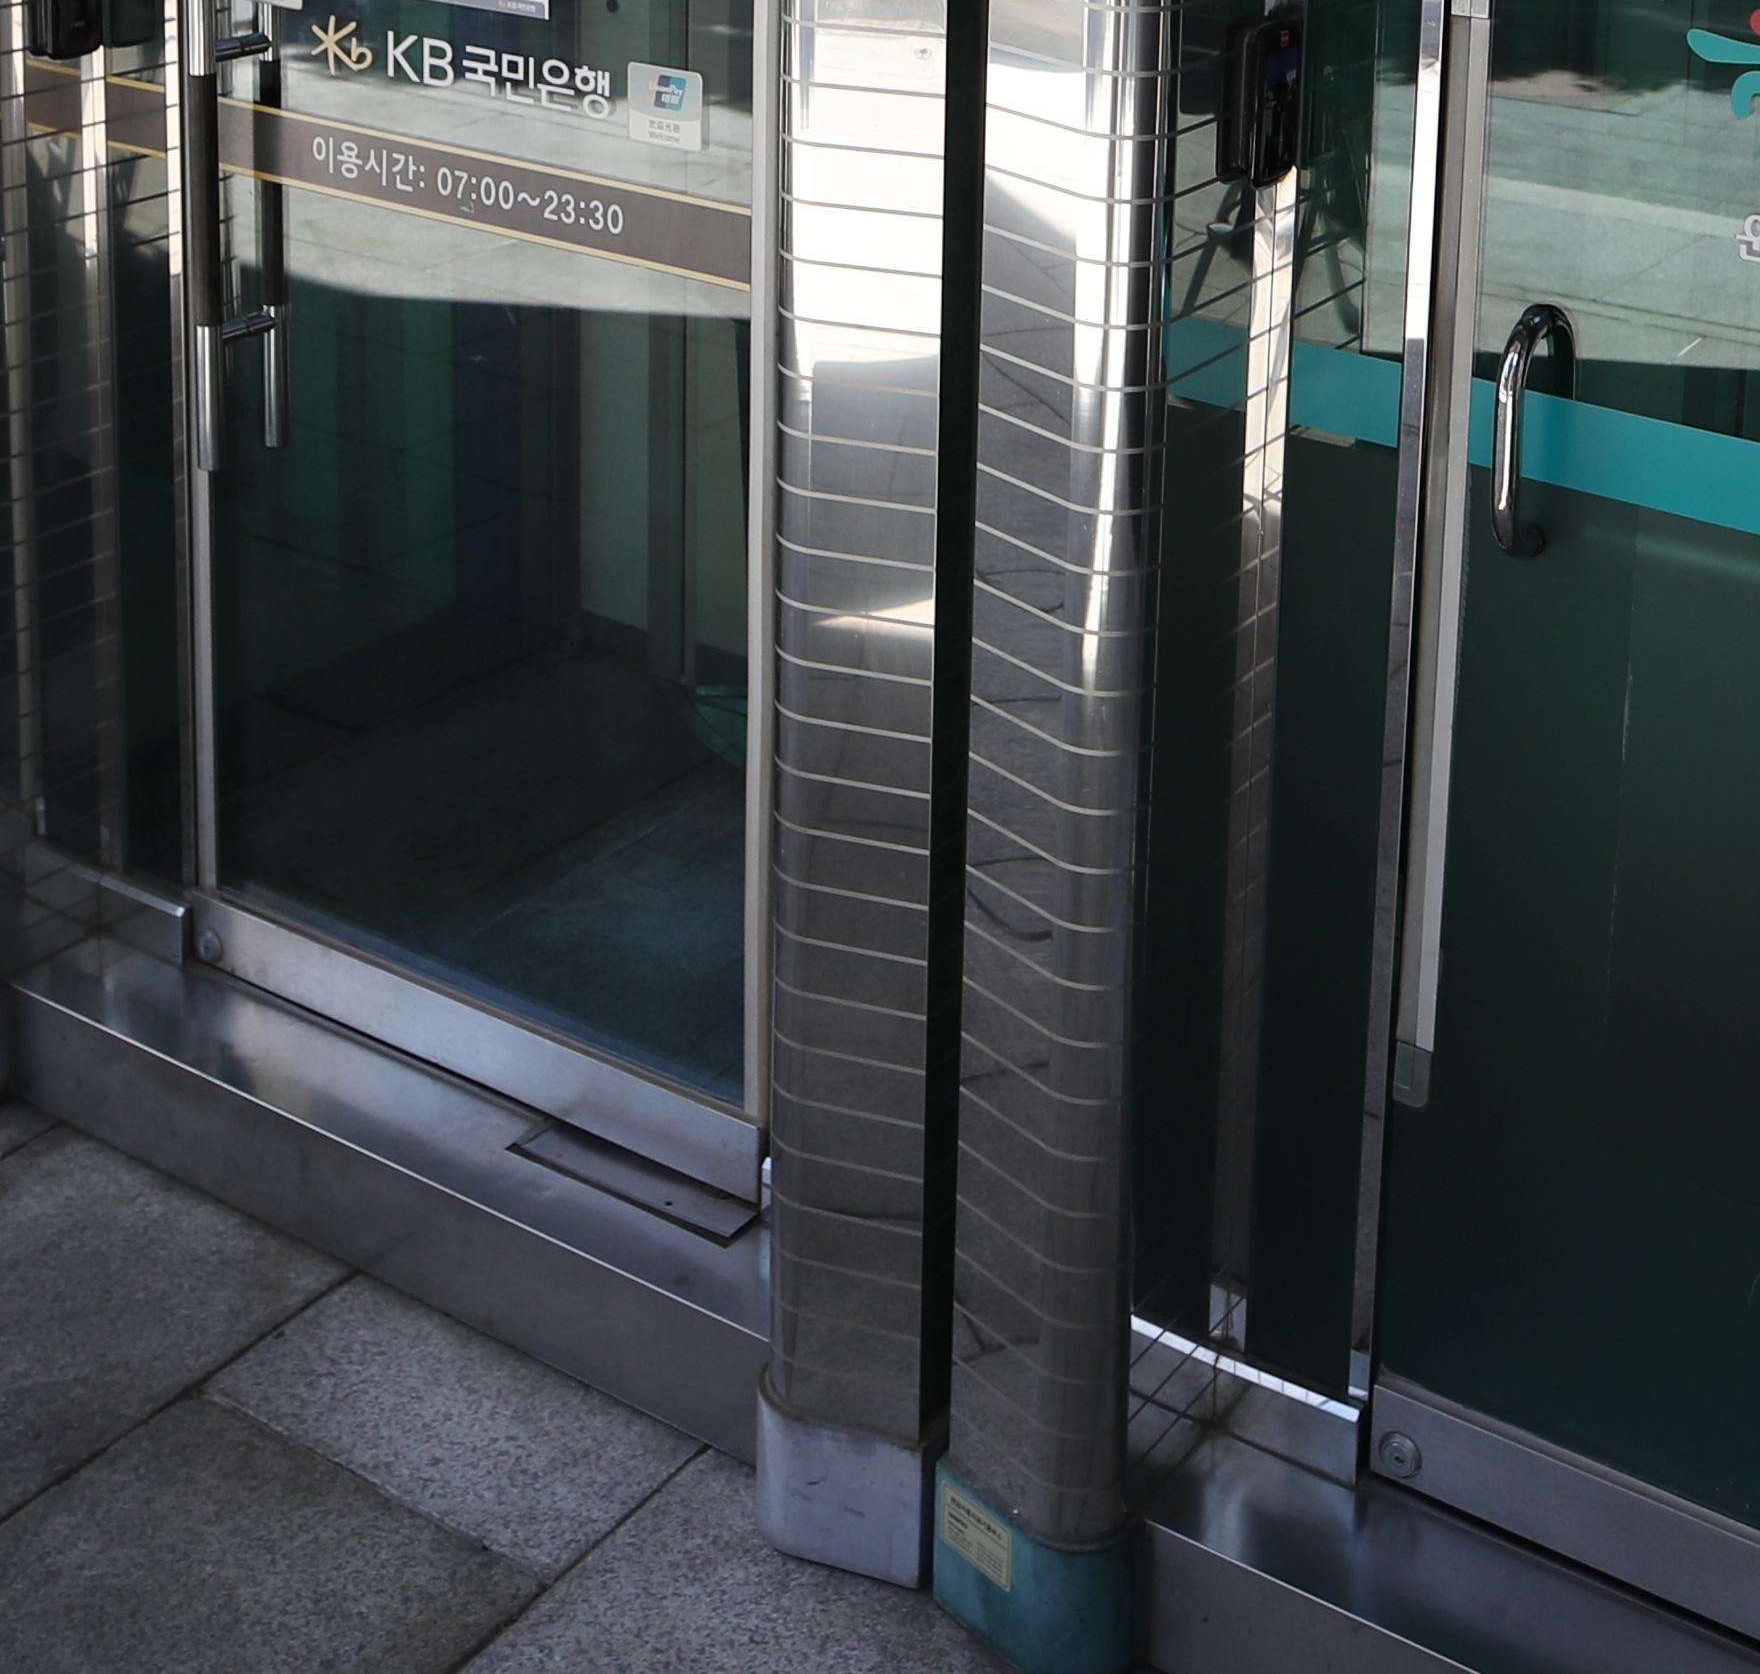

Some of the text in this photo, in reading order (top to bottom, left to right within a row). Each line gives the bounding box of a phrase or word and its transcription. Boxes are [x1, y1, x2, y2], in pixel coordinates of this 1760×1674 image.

[386, 29, 611, 120] KB국민은행
[312, 135, 625, 236] 이용시간: 07:00~23:30
